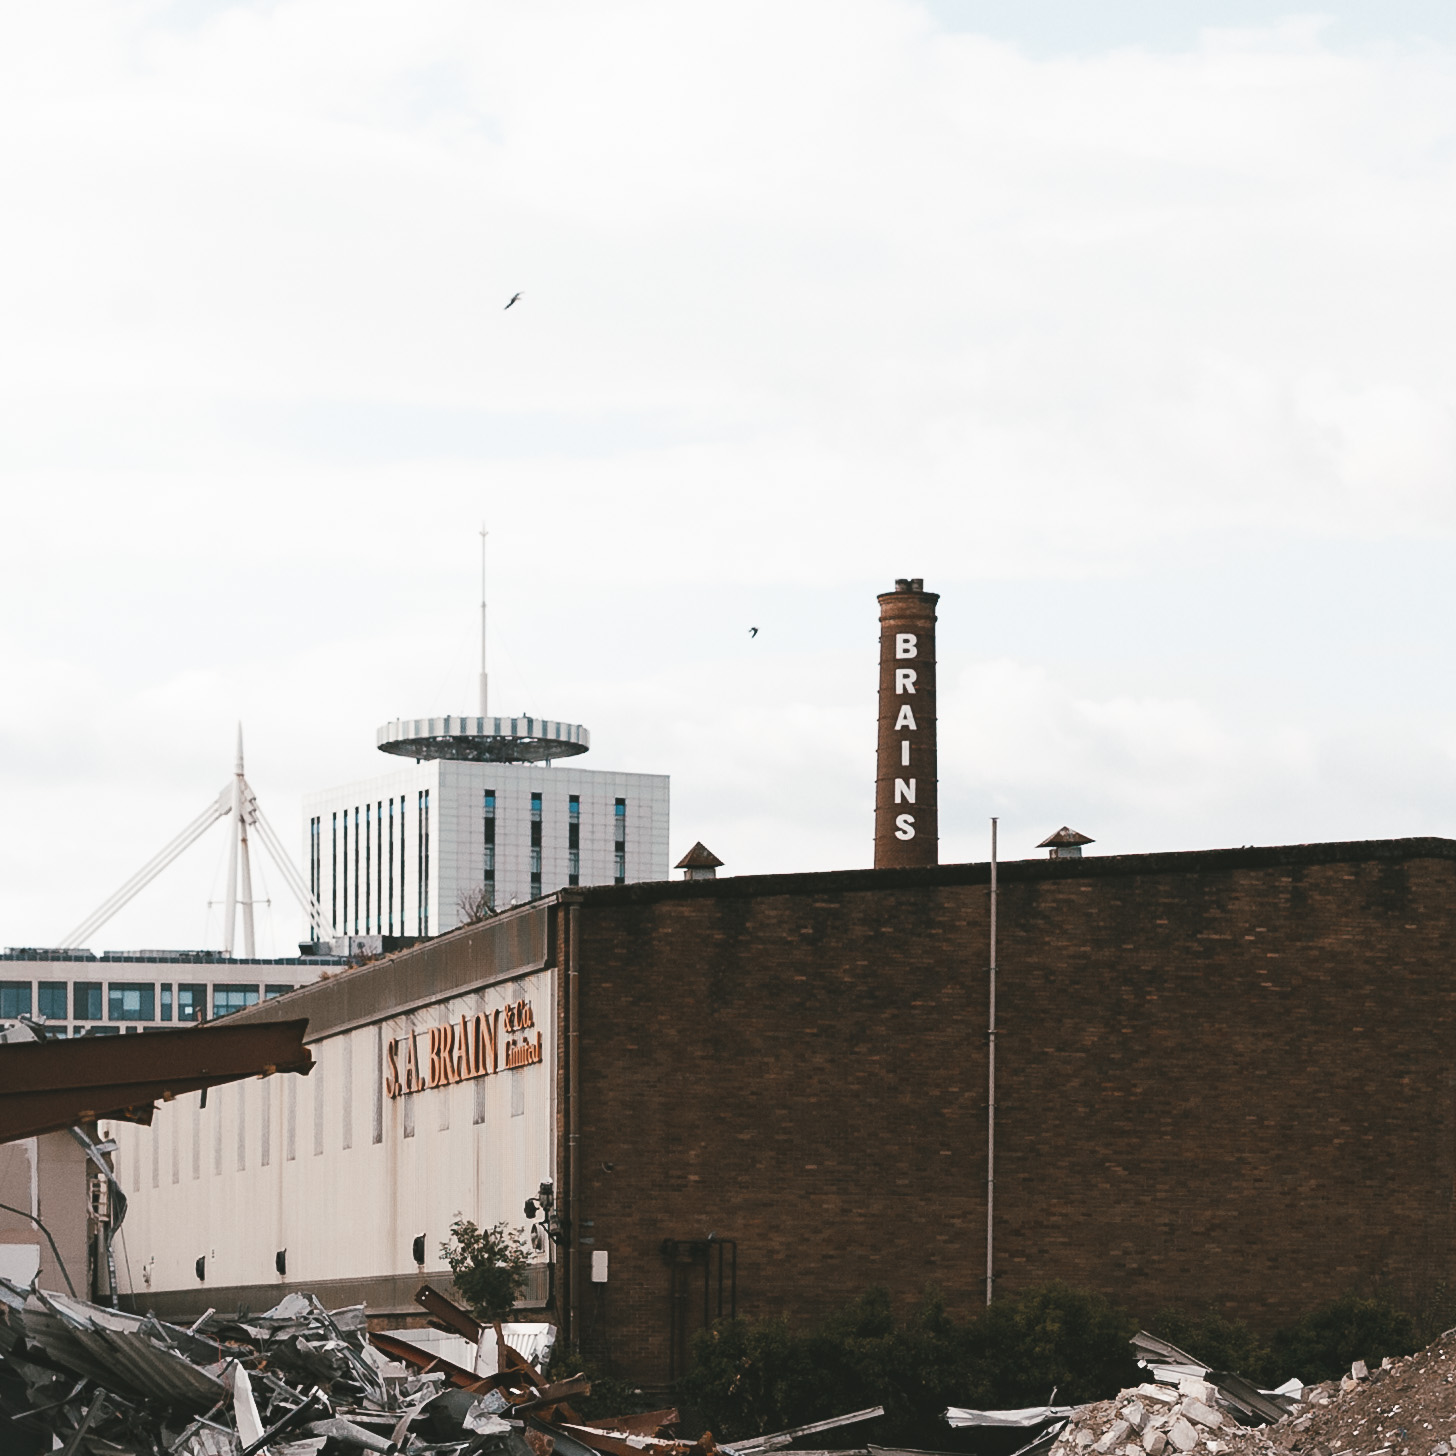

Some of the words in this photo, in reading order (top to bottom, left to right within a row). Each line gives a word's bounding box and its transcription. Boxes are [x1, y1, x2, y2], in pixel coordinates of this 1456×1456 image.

[894, 633, 918, 841] BRAINS
[504, 1004, 515, 1032] &
[427, 1008, 500, 1088] BRAIN
[505, 1031, 542, 1069] Limited
